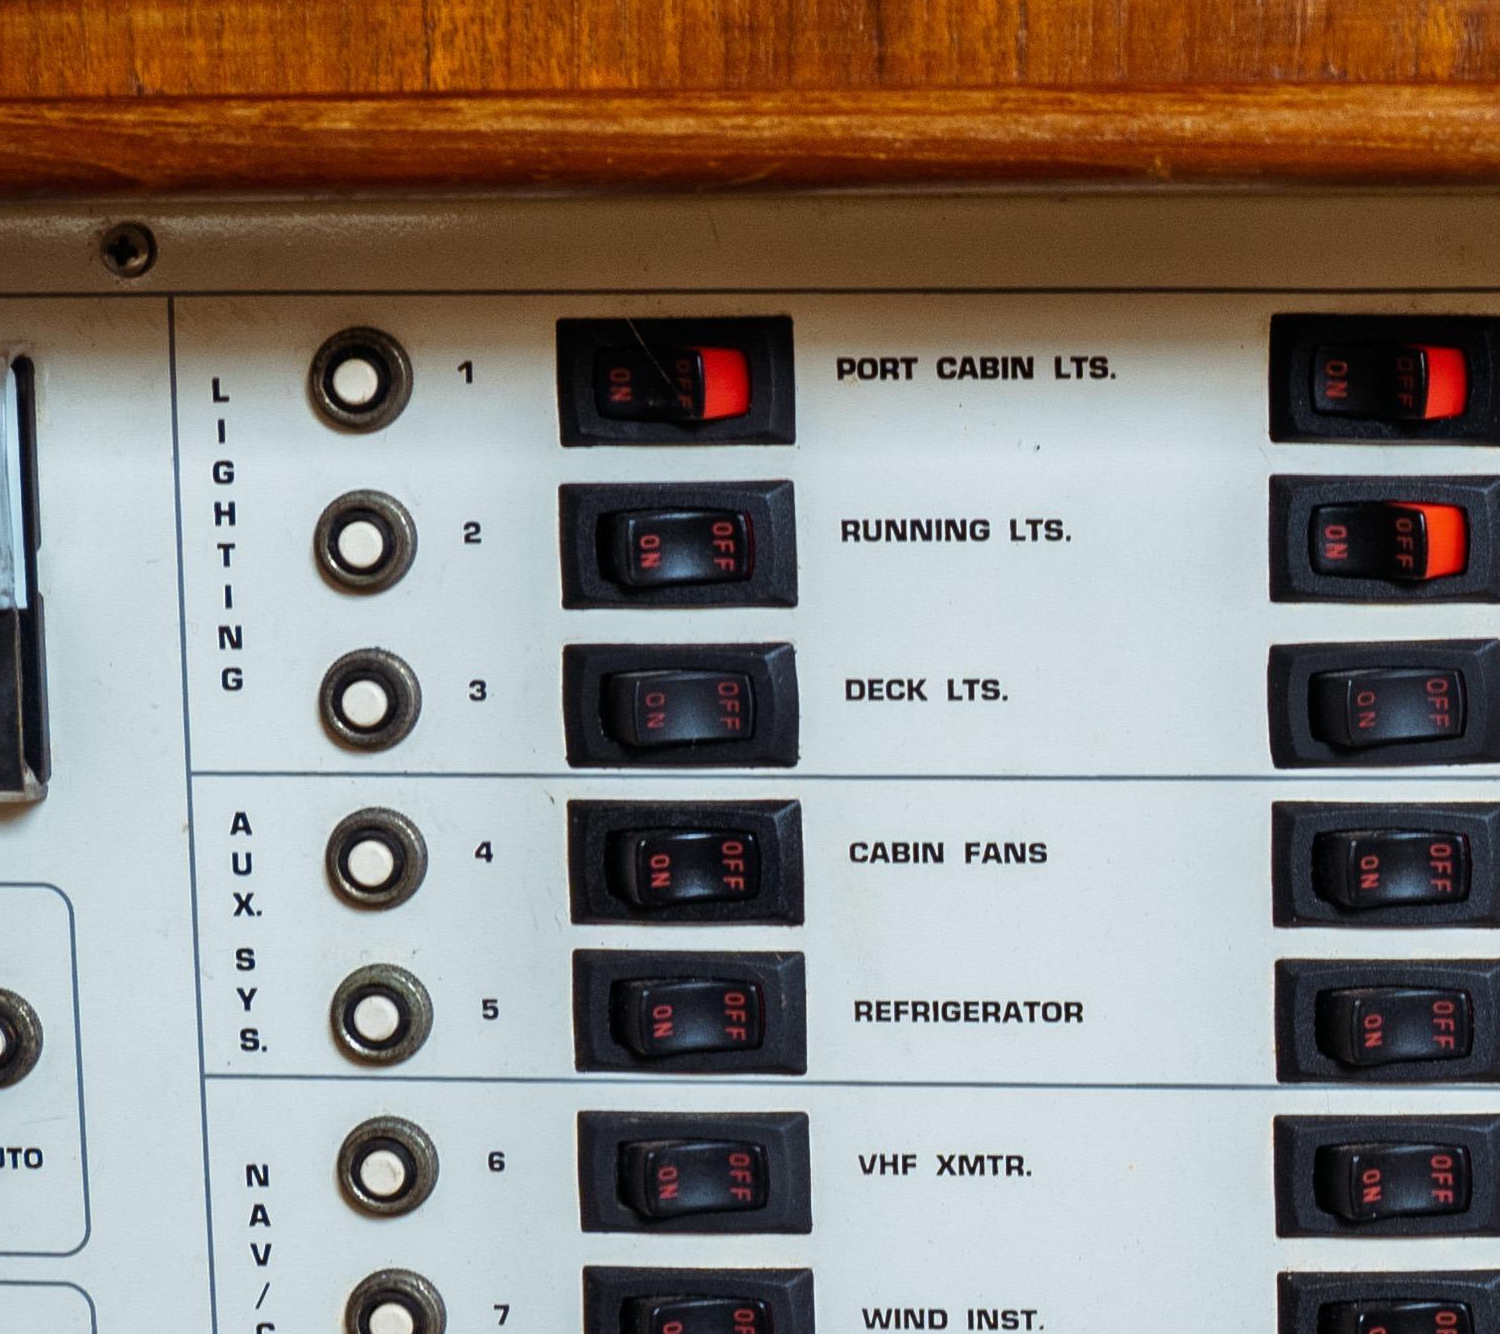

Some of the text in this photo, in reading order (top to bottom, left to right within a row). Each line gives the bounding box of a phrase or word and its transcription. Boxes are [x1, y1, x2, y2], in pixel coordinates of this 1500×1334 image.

[836, 355, 1116, 381] PORT CABIN LTS.
[211, 376, 244, 692] LIGHTING
[841, 518, 1071, 543] RUNNING LTS.
[845, 678, 1009, 702] DECK LTS.
[849, 841, 1048, 864] CABIN FANS
[650, 854, 670, 888] ON
[722, 842, 744, 890] OFF
[230, 811, 268, 1053] AUX. SYS.
[854, 1000, 1084, 1023] REFRIGERATOR
[858, 1153, 1032, 1177] VHF XMTR.
[1363, 1169, 1381, 1203] ON
[1431, 1155, 1453, 1204] OFF
[861, 1308, 1044, 1331] WIND INST.
